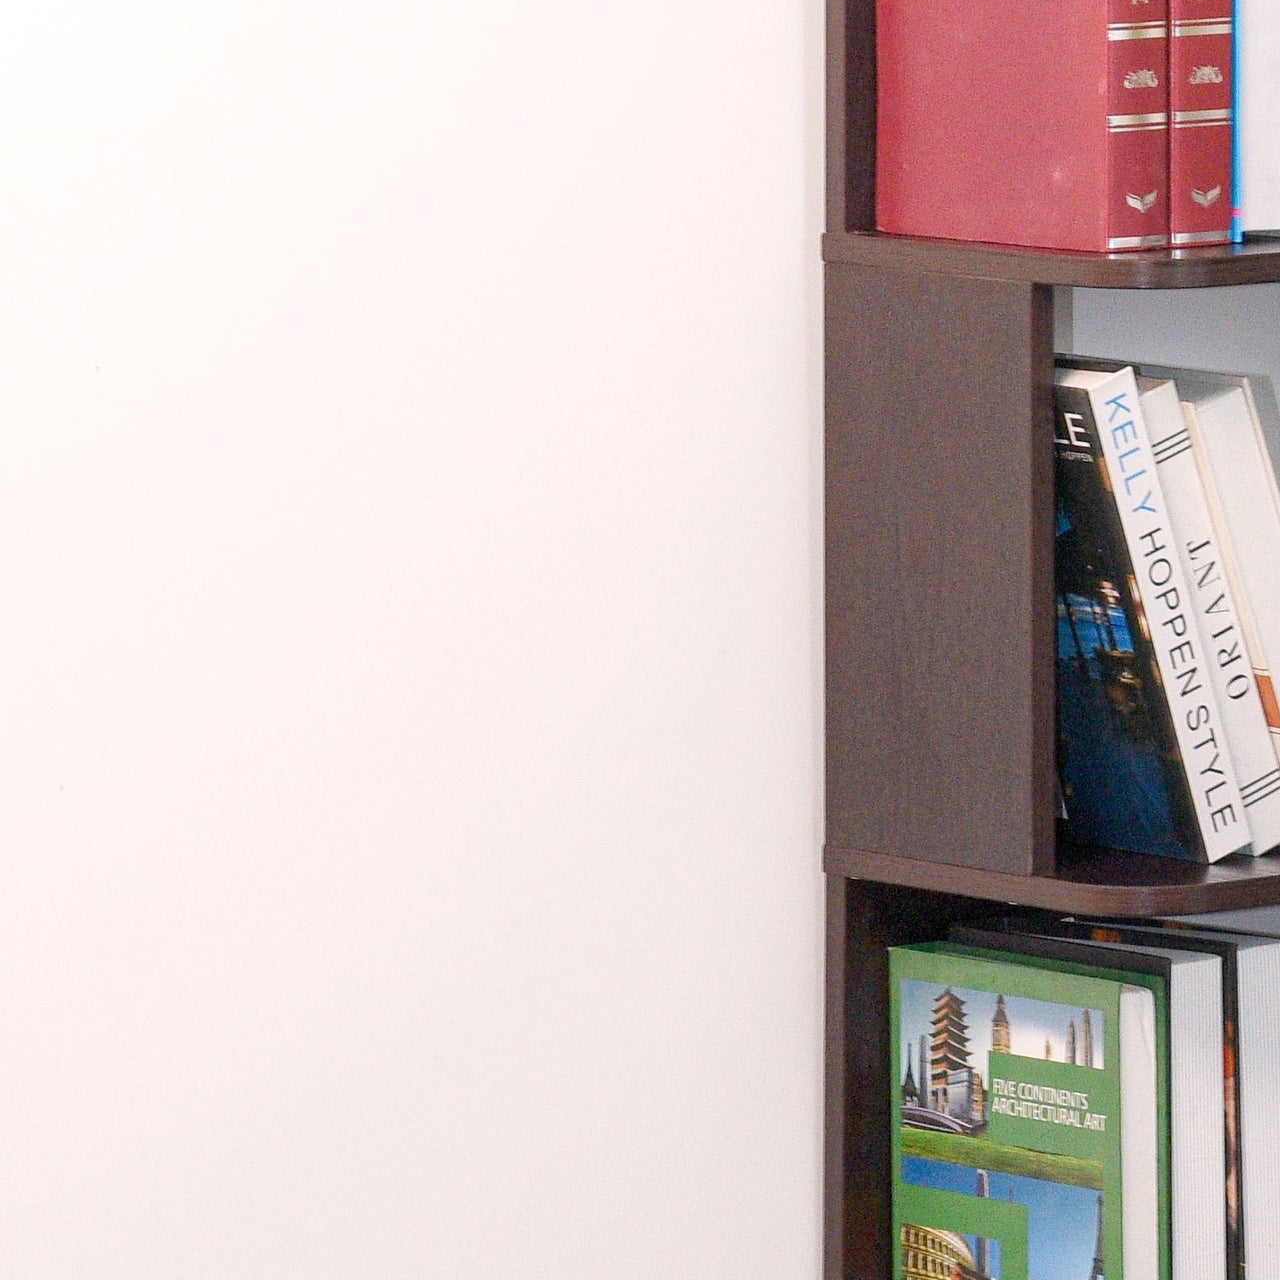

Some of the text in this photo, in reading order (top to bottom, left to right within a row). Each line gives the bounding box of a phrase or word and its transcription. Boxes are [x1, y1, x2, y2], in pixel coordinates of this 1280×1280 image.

[1105, 392, 1237, 833] KELLY HOPPEN STYLE
[1186, 540, 1251, 700] ORIANT
[991, 1096, 1108, 1131] ARCHITECTURAL ART
[993, 1078, 1089, 1110] FIVE CONTINENTS
